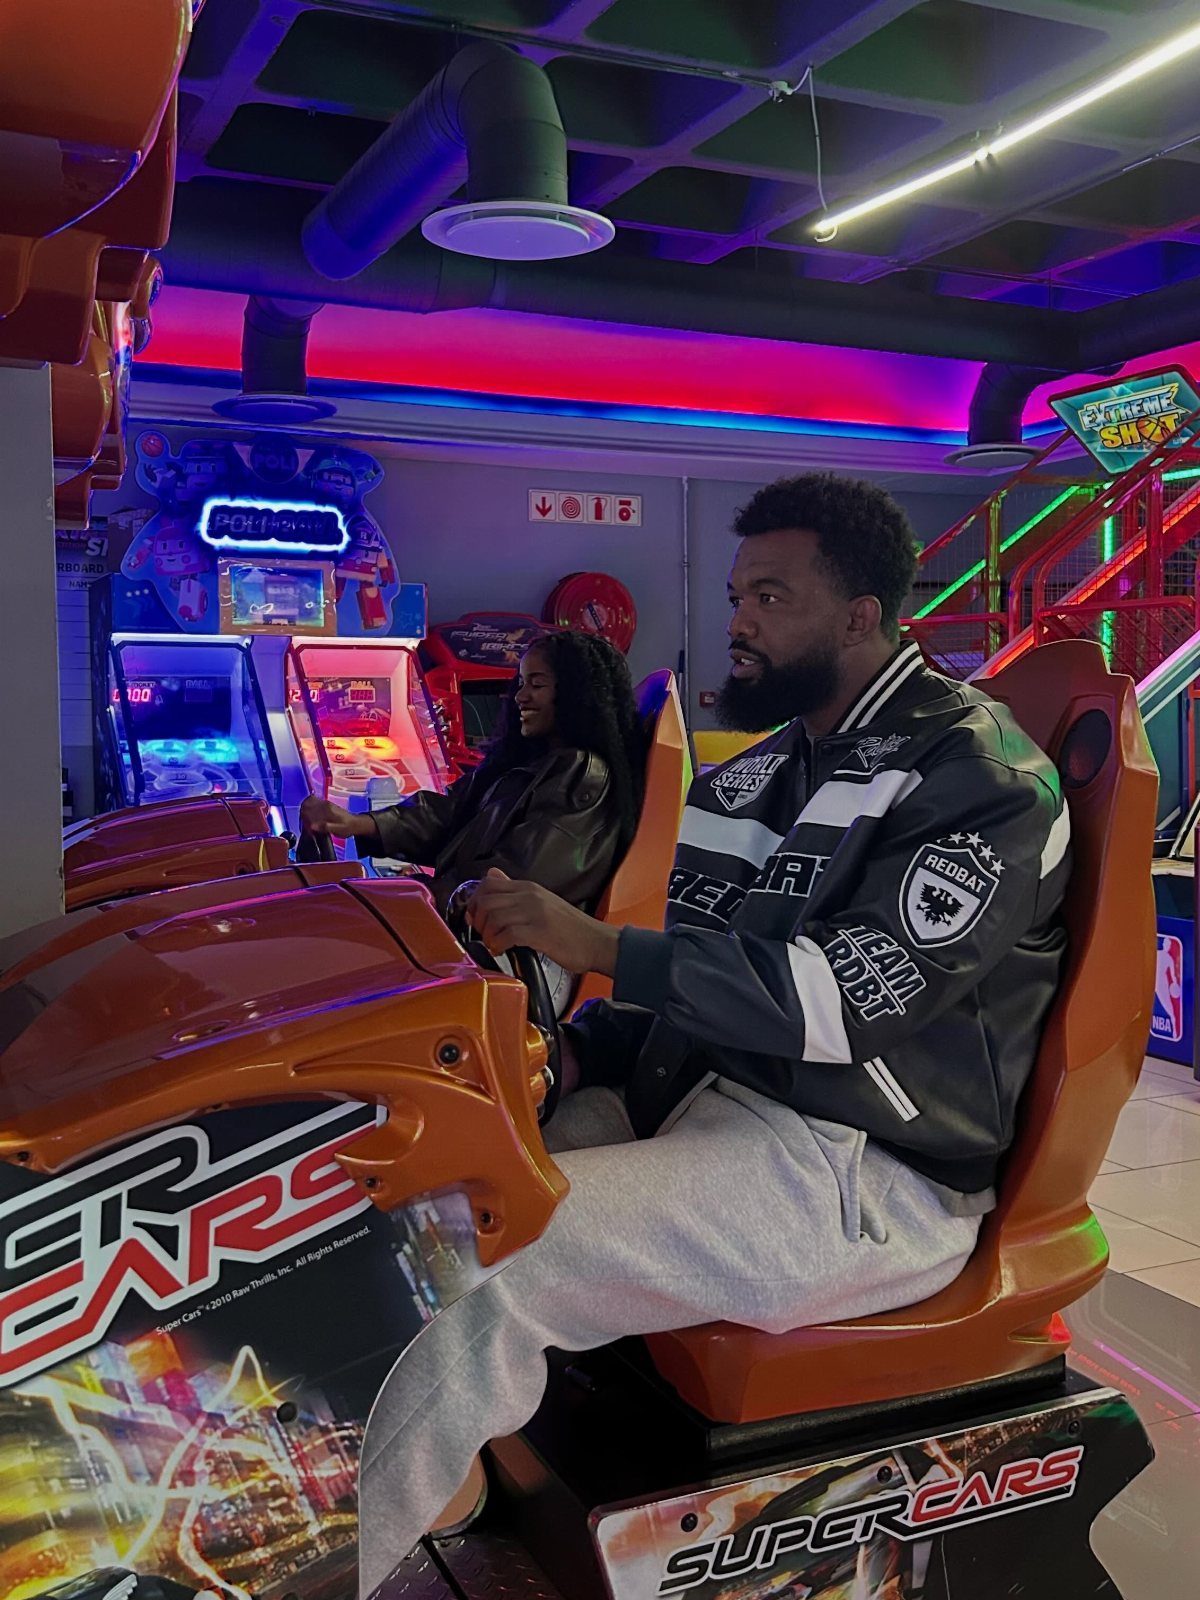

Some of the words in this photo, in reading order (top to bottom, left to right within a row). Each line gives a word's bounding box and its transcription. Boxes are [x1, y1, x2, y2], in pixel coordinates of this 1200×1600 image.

[1082, 392, 1175, 428] EXTREME
[725, 754, 789, 774] WORLD
[713, 772, 767, 791] SERIES
[925, 854, 987, 893] REDBAT
[1152, 1016, 1172, 1032] NBA
[156, 1319, 182, 1336] Super
[232, 1285, 250, 1300] Raw
[250, 1271, 278, 1291] Thrills,
[278, 1264, 293, 1278] Inc.
[296, 1257, 307, 1269] All
[307, 1244, 333, 1262] Rights
[333, 1225, 372, 1250] Reserved.
